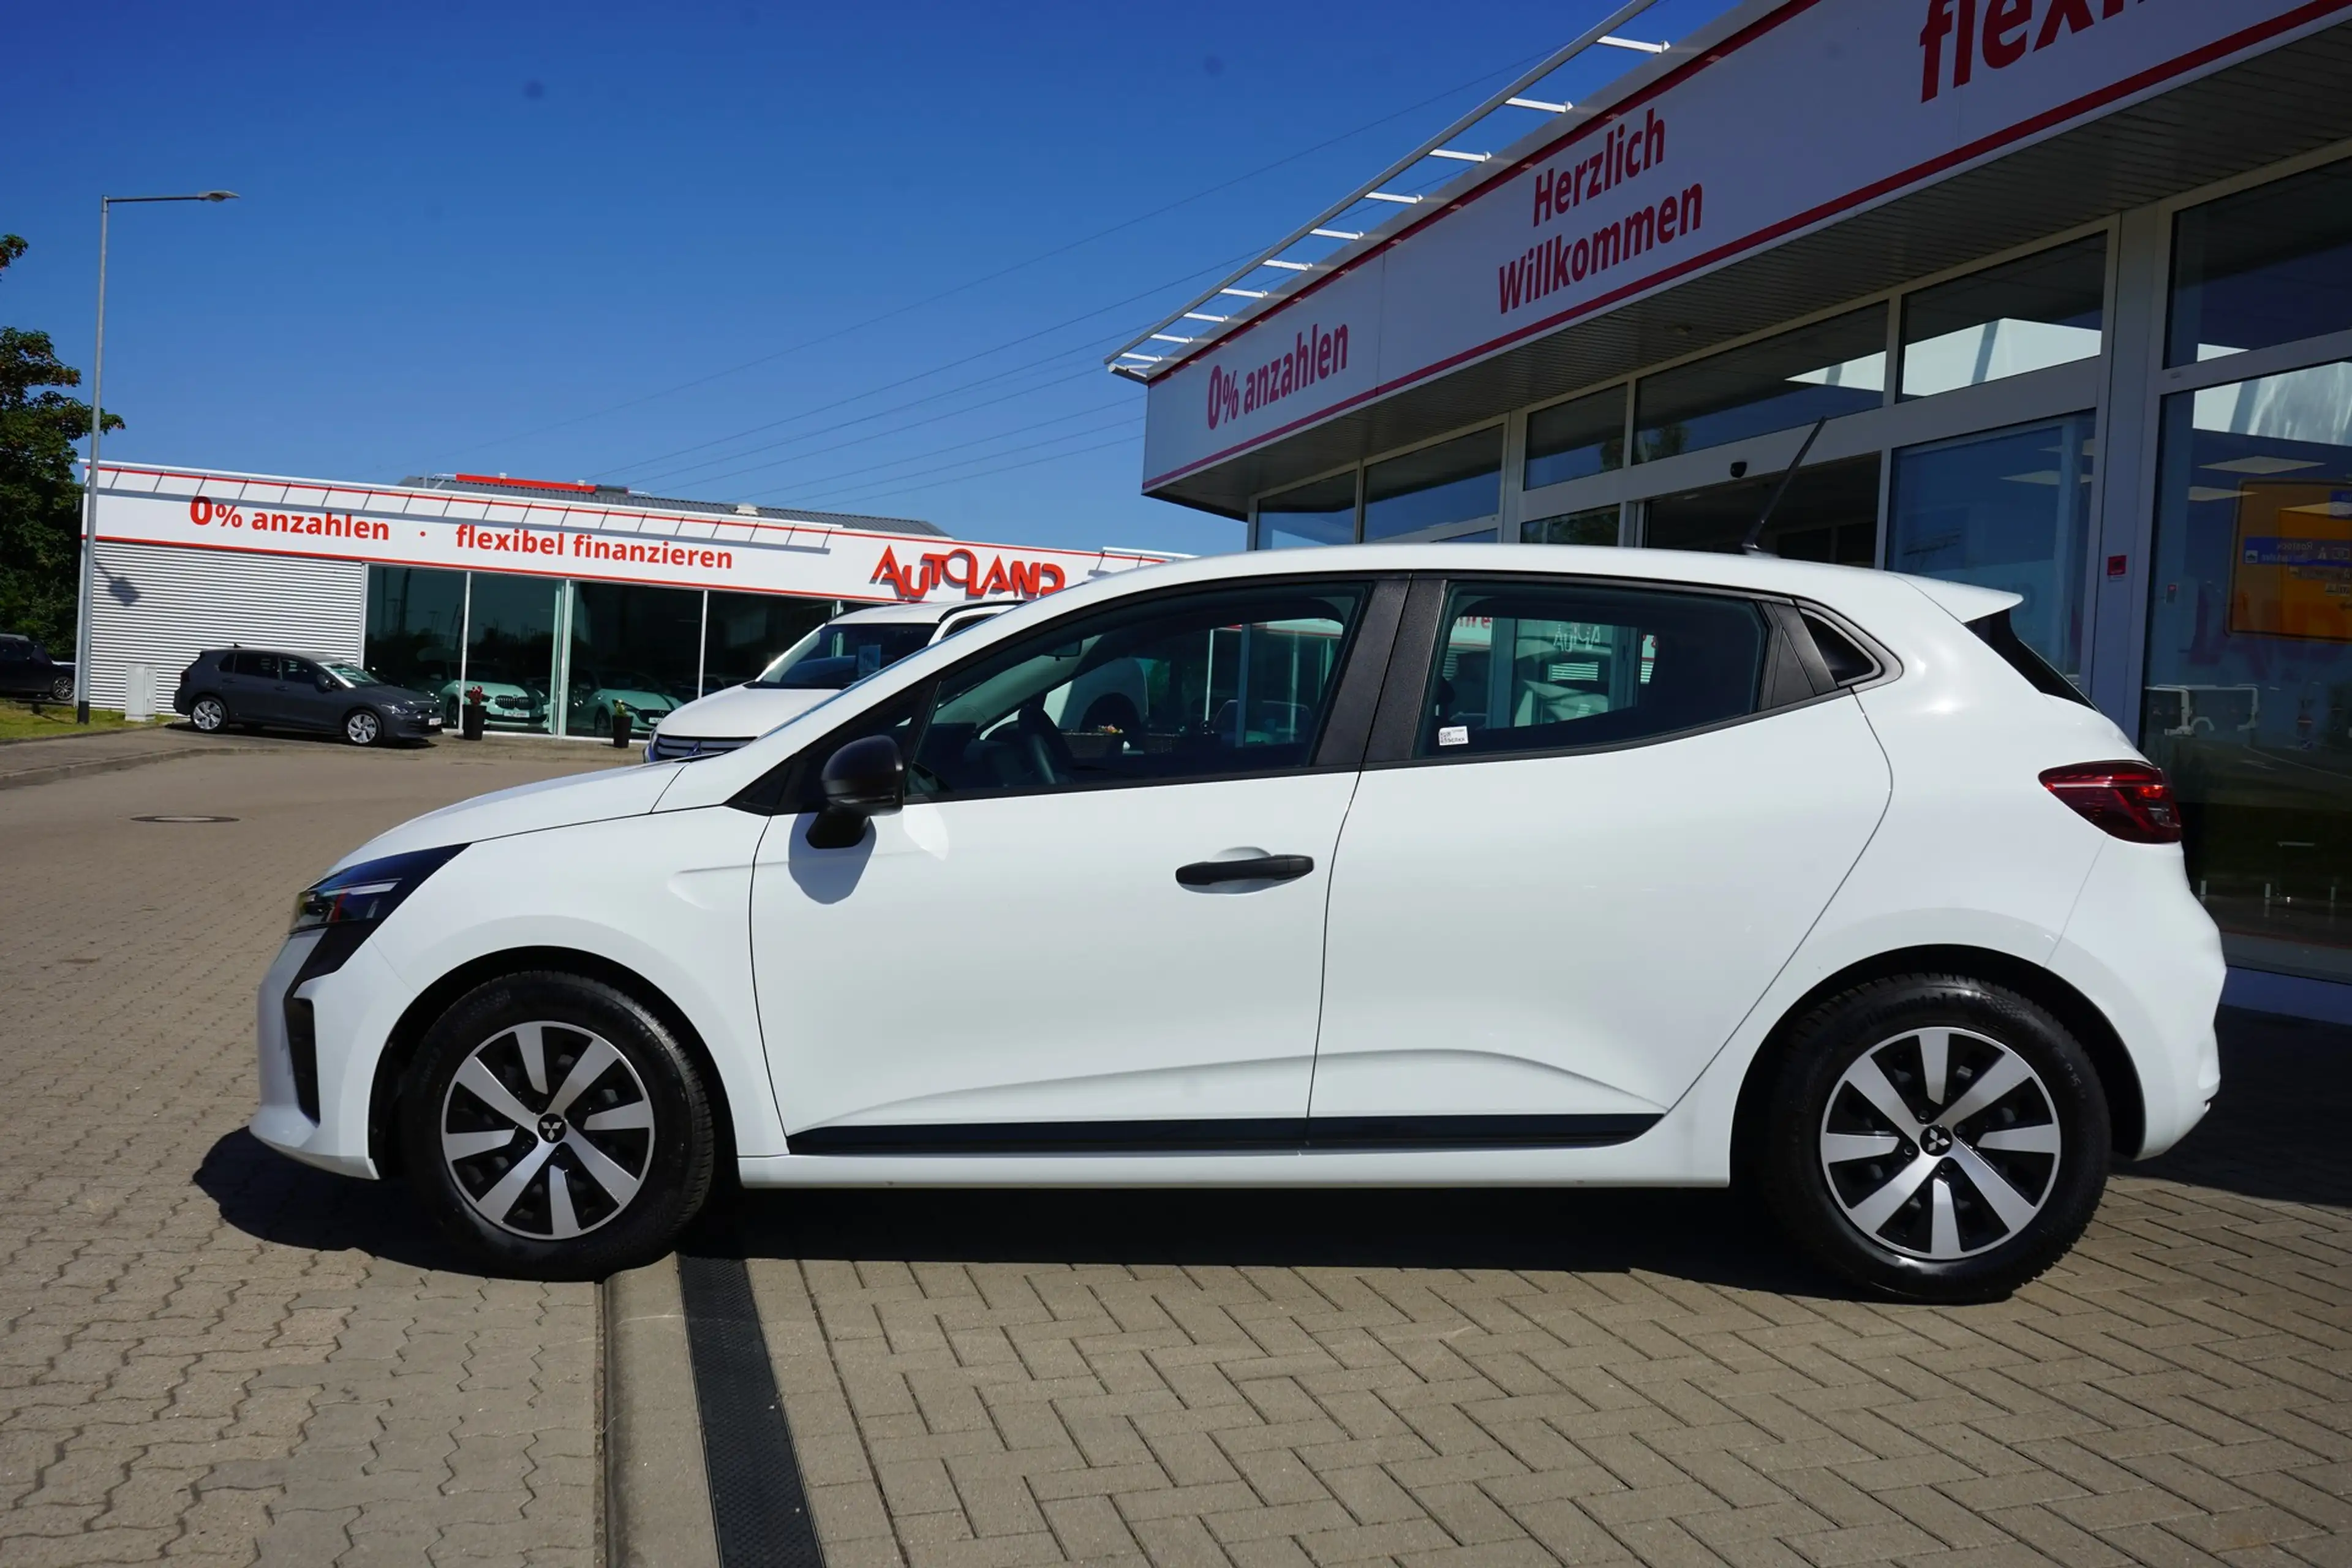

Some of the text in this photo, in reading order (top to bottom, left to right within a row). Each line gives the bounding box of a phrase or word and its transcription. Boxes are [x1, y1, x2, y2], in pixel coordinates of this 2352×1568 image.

[1920, 0, 2145, 103] flex
[1534, 107, 1665, 227] Herzlich
[1499, 183, 1703, 314] Willkommen
[1207, 323, 1348, 430] 0% anzahlen
[189, 496, 733, 569] 0% anzahlen flexibel finanzieren
[872, 545, 1066, 598] AUTOLAND
